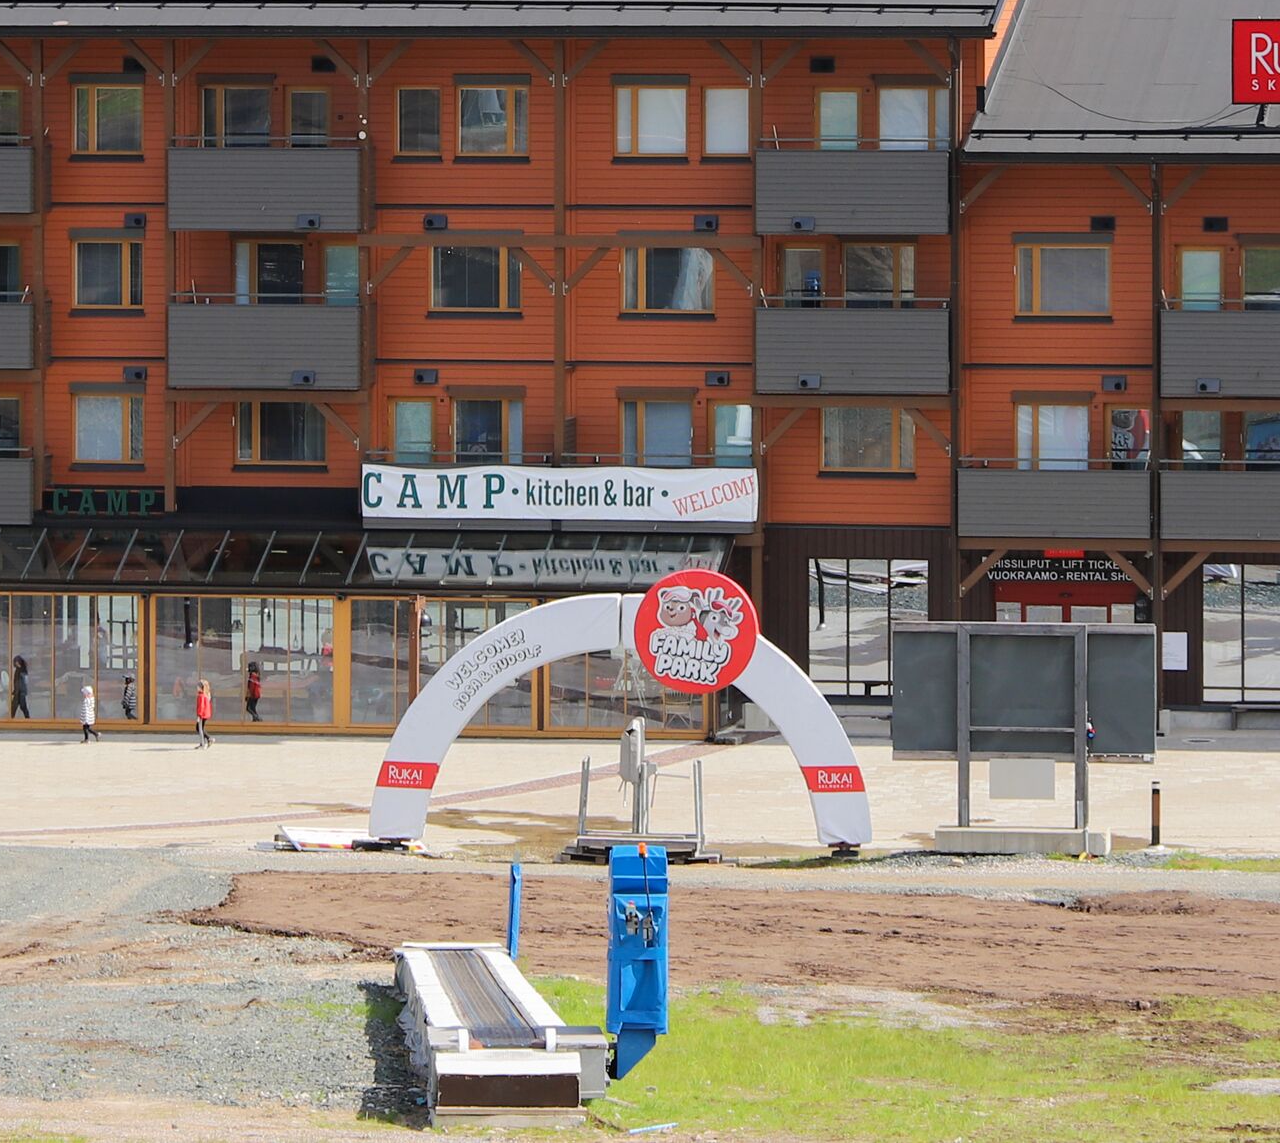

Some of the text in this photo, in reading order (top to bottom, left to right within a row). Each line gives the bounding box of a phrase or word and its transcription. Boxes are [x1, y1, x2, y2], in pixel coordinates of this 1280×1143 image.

[52, 488, 156, 516] CAMP
[363, 471, 506, 510] CAMP
[525, 476, 600, 507] kitchen
[604, 480, 618, 507] &
[623, 478, 656, 508] bar
[987, 571, 1059, 581] VUOKRAAMO
[1066, 572, 1109, 581] RENTAL
[1062, 560, 1085, 569] LIFT
[445, 628, 527, 691] WELCOME!
[650, 635, 728, 665] FAMILY
[453, 644, 544, 712] ROSA & RUDOLF
[657, 654, 719, 683] PARK
